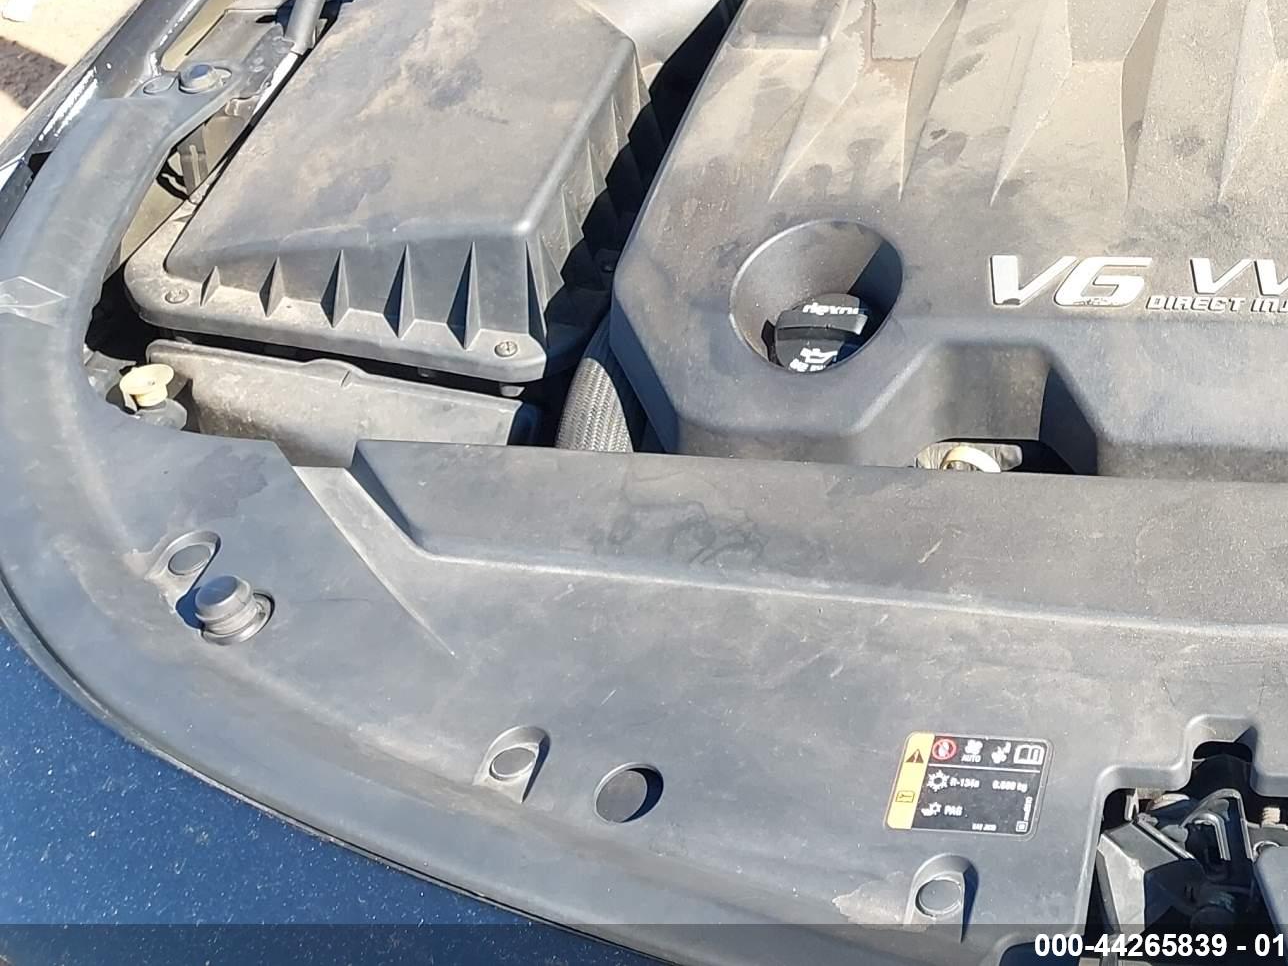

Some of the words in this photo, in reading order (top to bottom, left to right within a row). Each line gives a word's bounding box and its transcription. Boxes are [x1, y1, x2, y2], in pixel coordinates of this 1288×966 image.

[990, 254, 1152, 308] V6
[1146, 295, 1246, 313] DIRECT
[961, 754, 981, 762] AUTO
